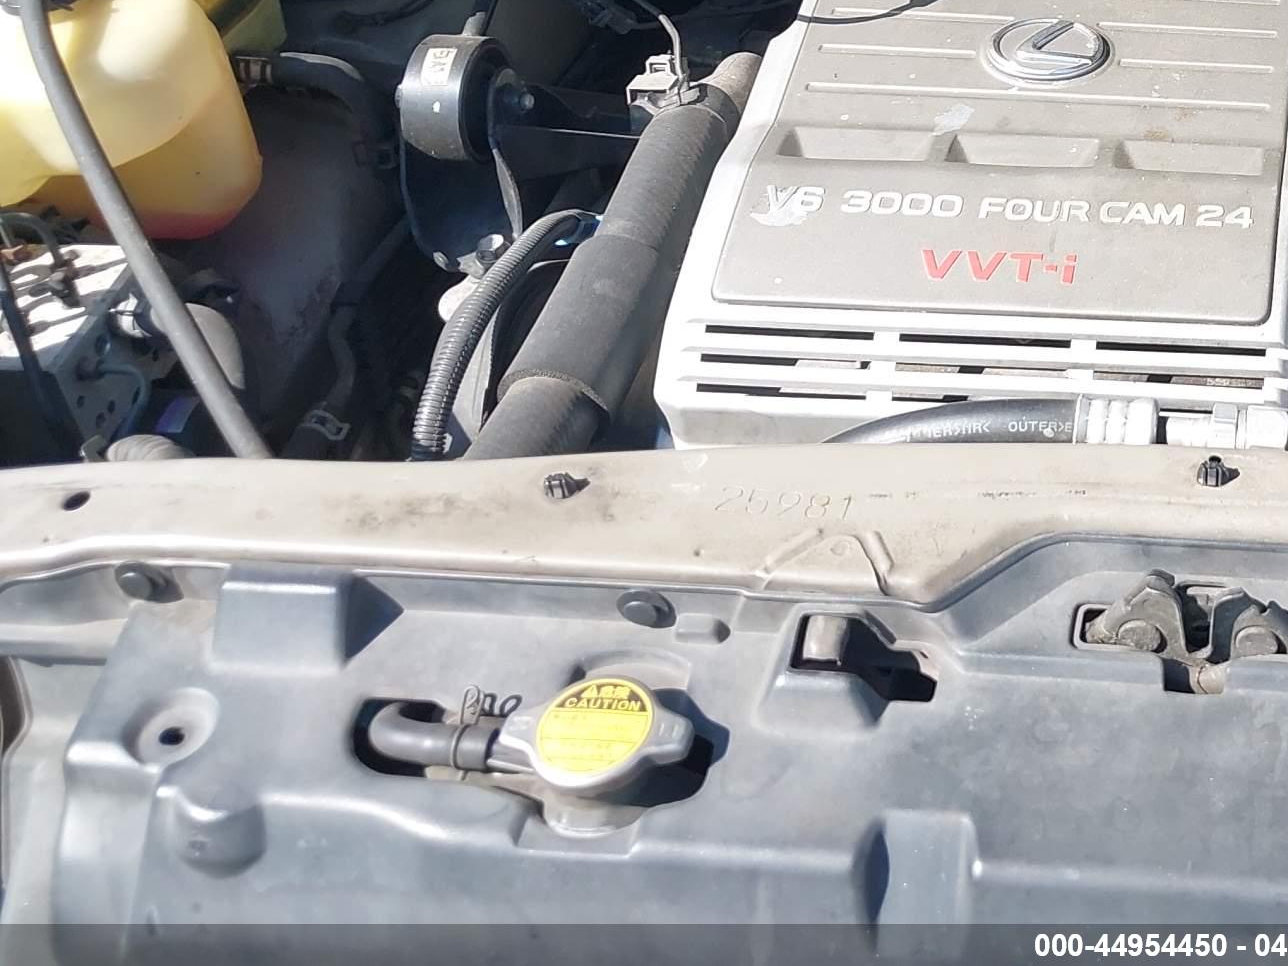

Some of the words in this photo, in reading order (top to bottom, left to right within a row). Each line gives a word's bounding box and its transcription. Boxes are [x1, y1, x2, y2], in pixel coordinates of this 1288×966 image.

[766, 184, 825, 212] V6
[840, 190, 964, 218] 3000
[978, 196, 1090, 224] FOUR
[1099, 201, 1186, 226] CAM
[1195, 203, 1255, 230] 24
[921, 248, 1079, 285] VVT-i
[564, 697, 641, 712] CAUTION
